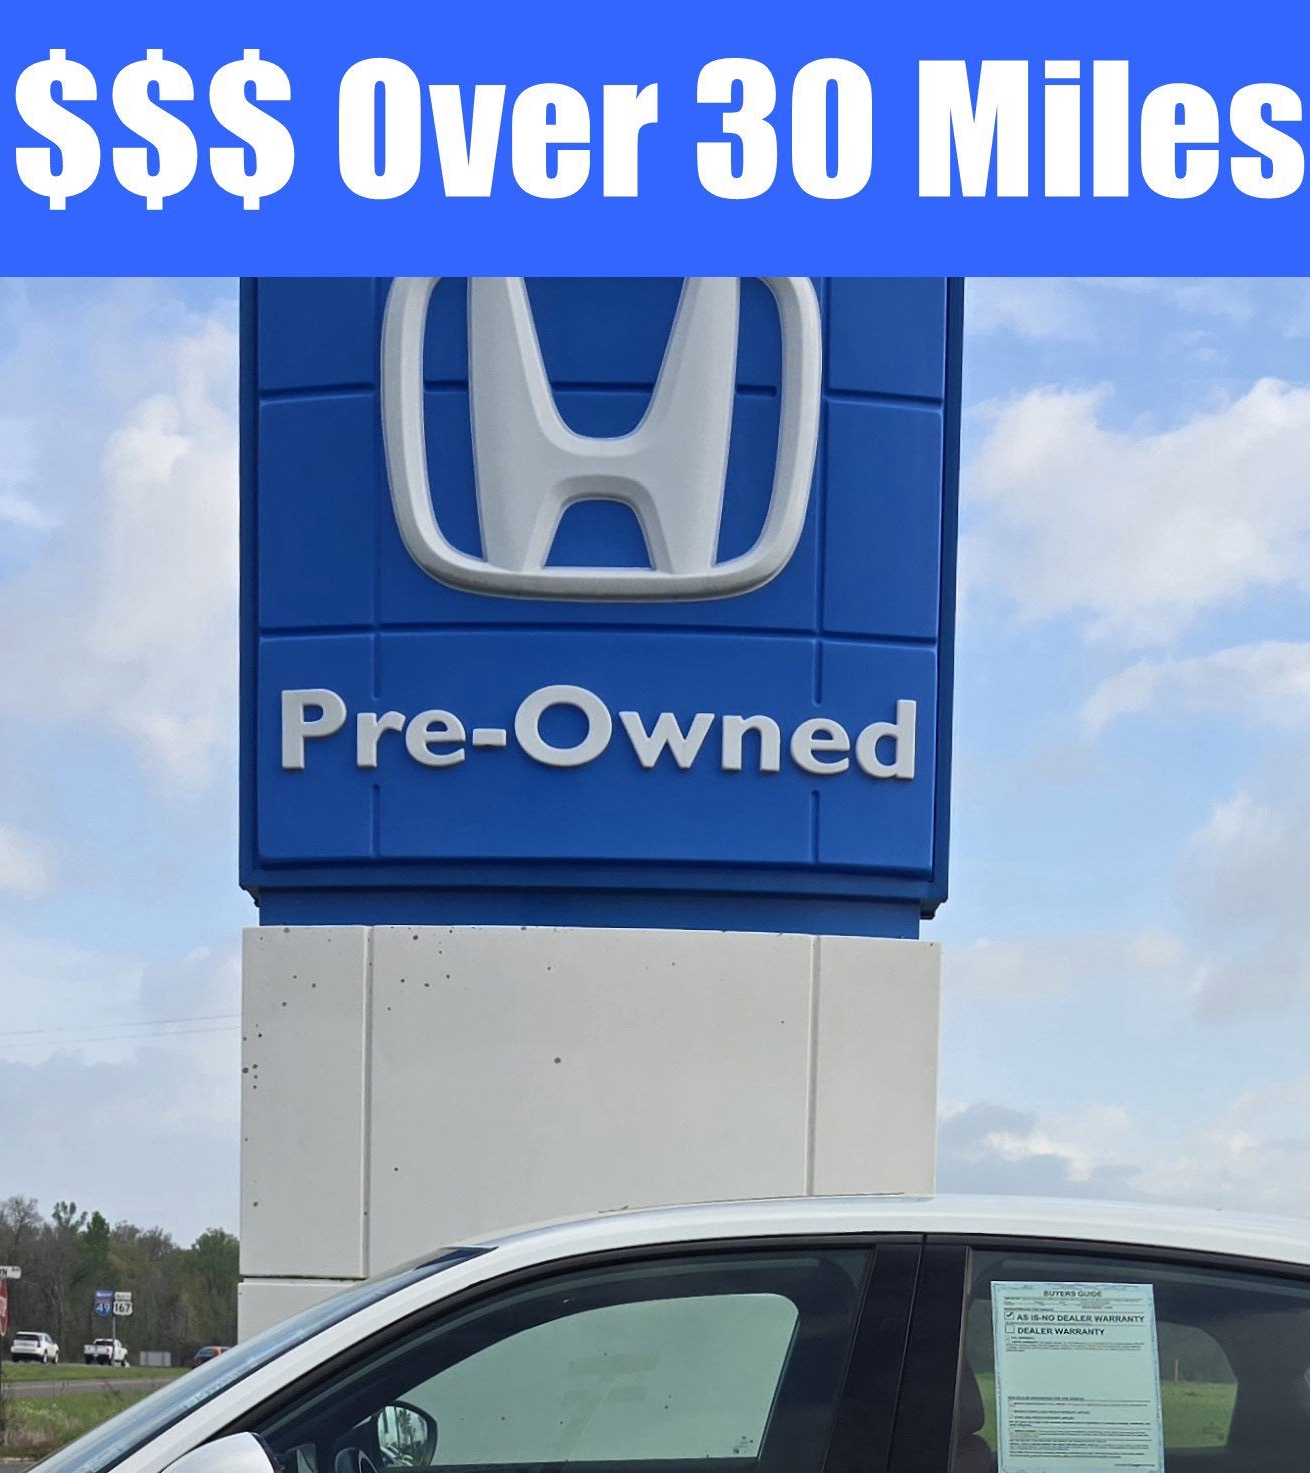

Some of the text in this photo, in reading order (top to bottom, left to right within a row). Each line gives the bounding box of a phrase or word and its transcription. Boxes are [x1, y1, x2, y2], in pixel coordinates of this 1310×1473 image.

[281, 684, 918, 780] Pre-Owned
[1043, 1290, 1102, 1298] BUYERS GUIDE
[115, 1302, 131, 1313] 167
[1016, 1314, 1029, 1322] AS
[1094, 1315, 1145, 1323] WARRANTY
[1017, 1327, 1105, 1336] DEALER WARRANTY
